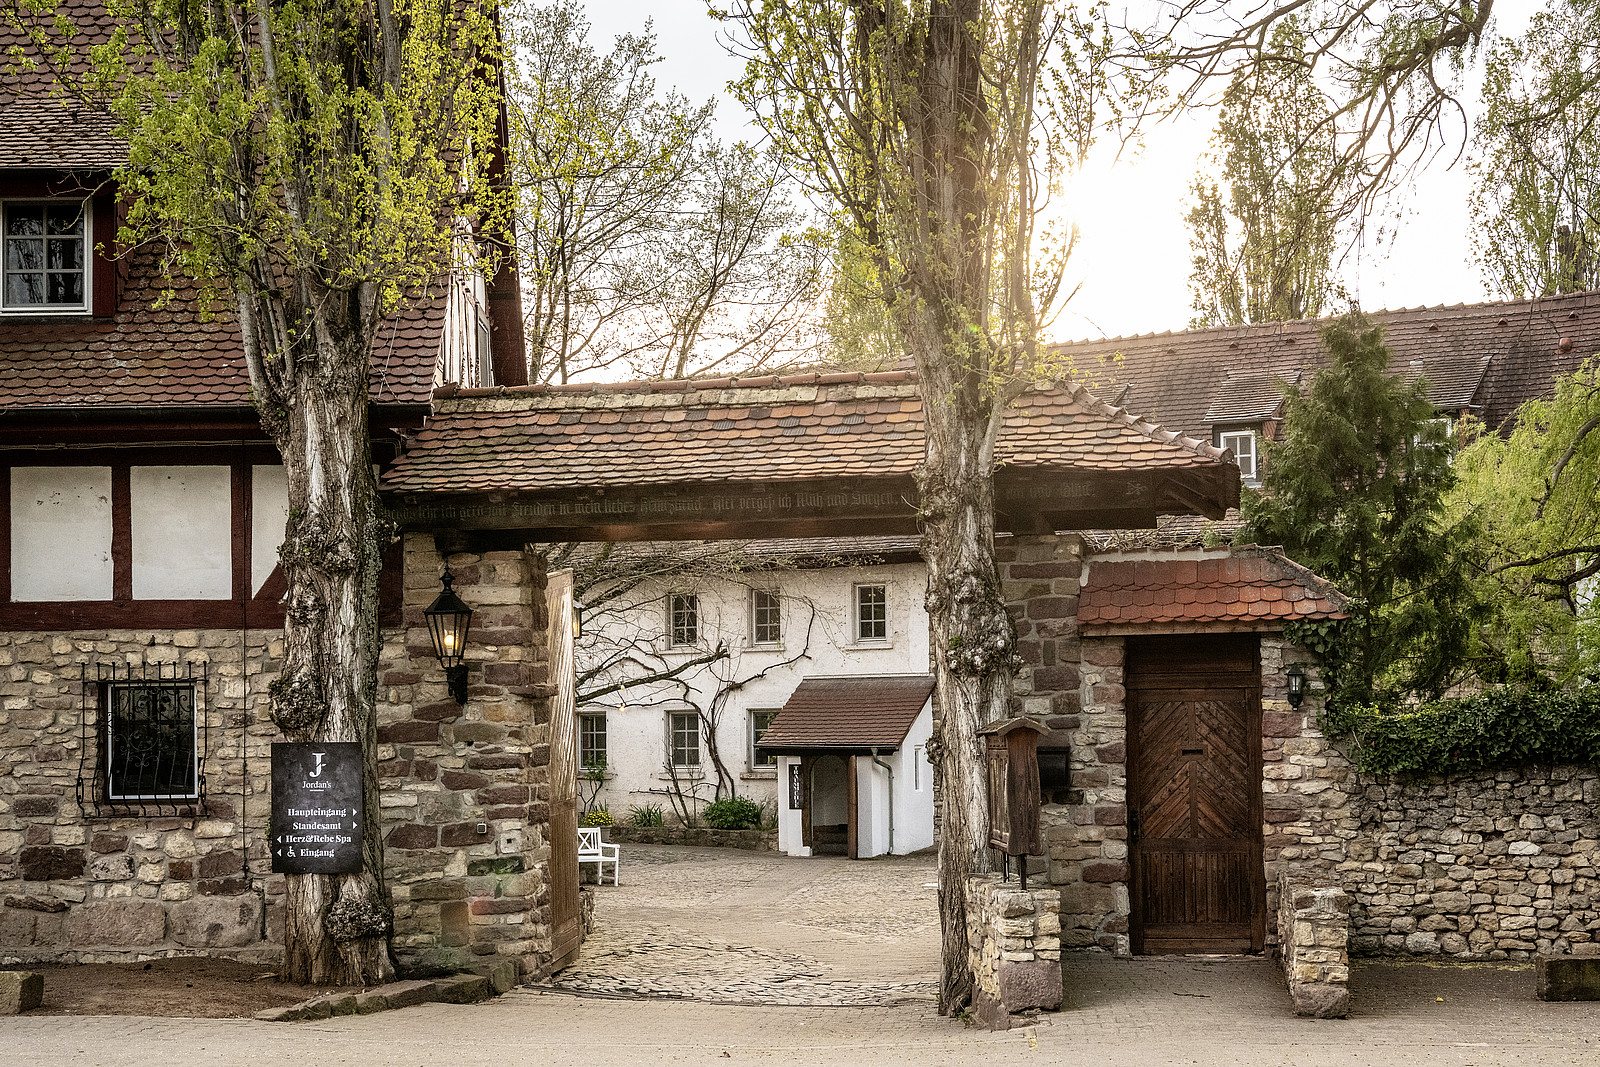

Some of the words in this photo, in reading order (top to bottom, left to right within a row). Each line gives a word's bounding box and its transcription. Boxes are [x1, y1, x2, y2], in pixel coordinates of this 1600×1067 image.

[511, 501, 556, 518] Freuden
[559, 501, 573, 515] in
[574, 499, 601, 514] mein
[604, 498, 635, 514] liebes
[778, 492, 792, 512] ich
[827, 491, 848, 508] und
[302, 780, 332, 789] Jordan's
[287, 808, 347, 818] Haupteingang
[292, 821, 341, 830] Standesamt
[286, 834, 335, 843] Herz&Rebe
[335, 834, 352, 844] Spa
[300, 848, 335, 858] Eingang
